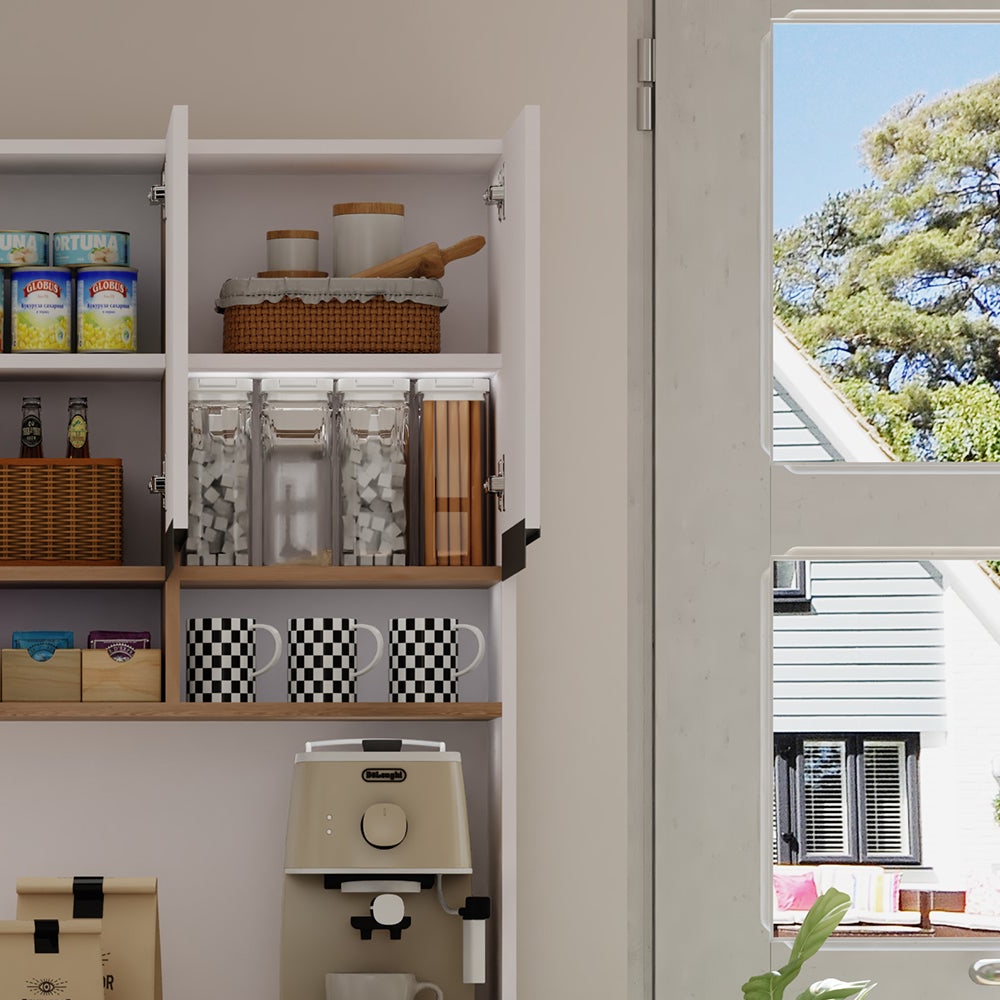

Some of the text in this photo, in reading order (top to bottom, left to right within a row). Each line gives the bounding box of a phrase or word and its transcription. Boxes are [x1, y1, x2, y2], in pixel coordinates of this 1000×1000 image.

[54, 233, 118, 251] ORTUNA
[26, 281, 58, 293] GLOBUS
[92, 281, 125, 293] GLOBUS
